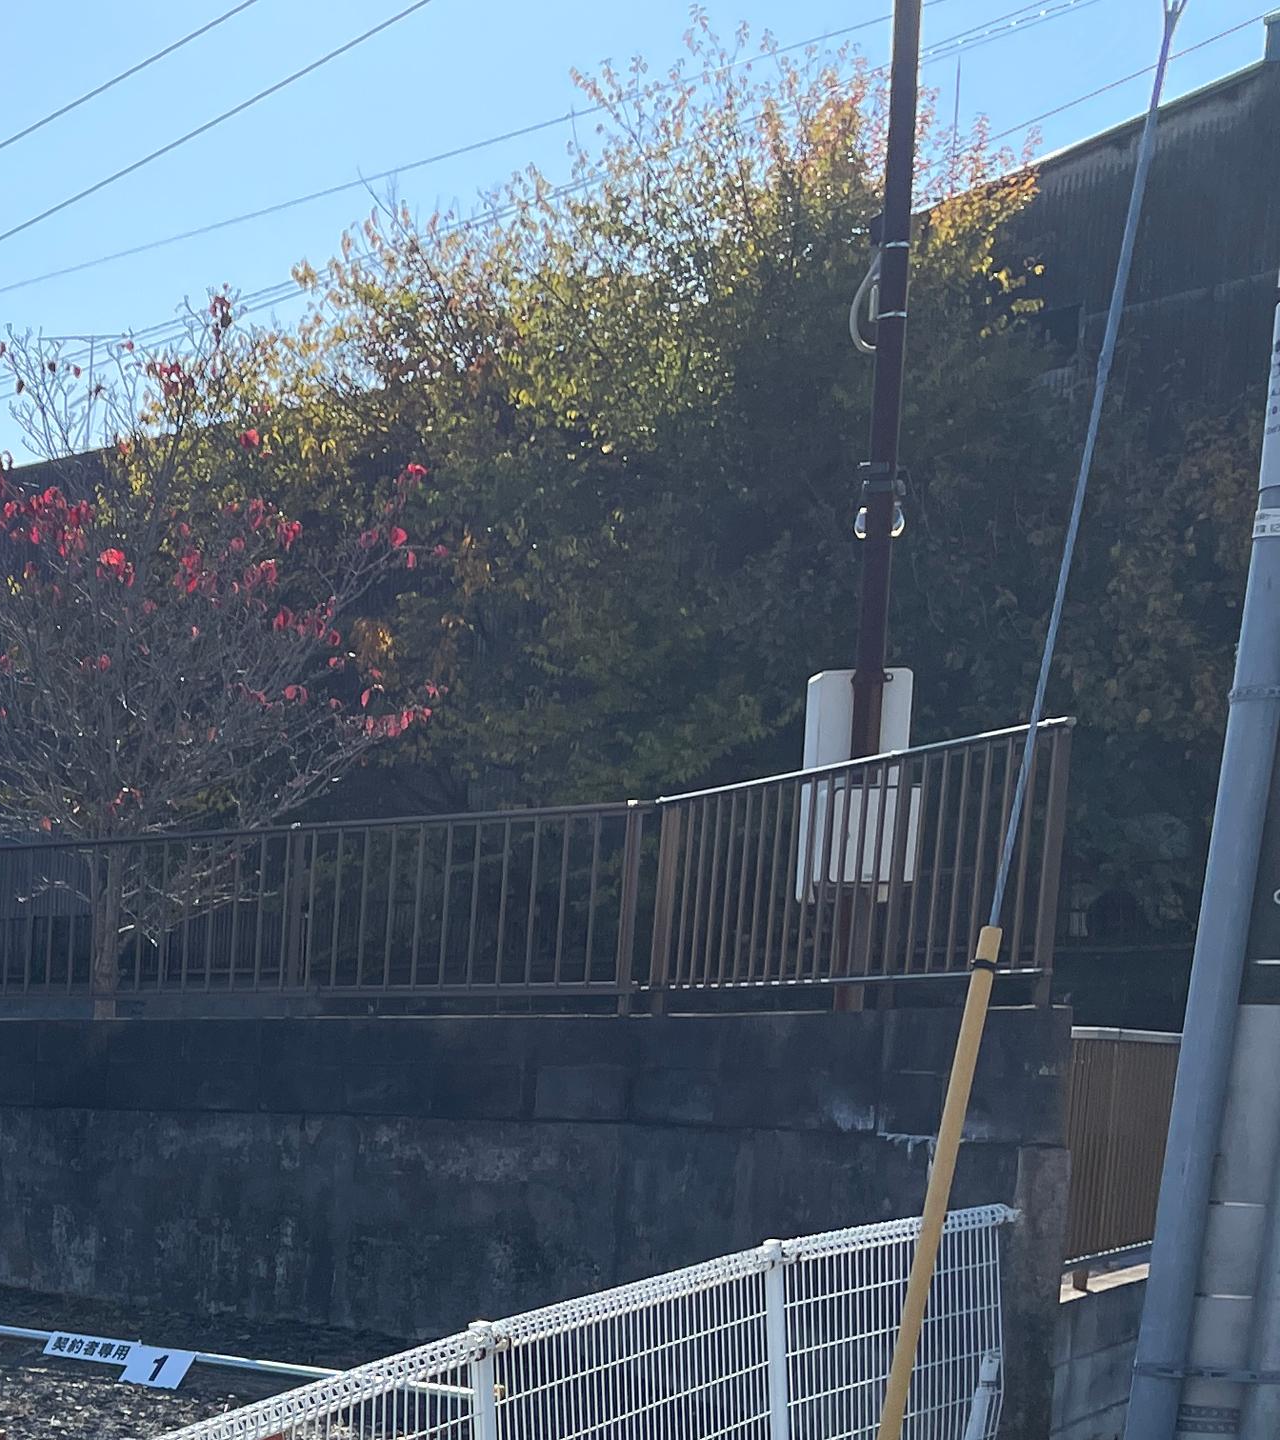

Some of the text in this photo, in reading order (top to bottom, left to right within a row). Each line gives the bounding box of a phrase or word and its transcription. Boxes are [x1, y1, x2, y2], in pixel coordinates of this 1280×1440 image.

[51, 1336, 169, 1381] 契約者専用 1
